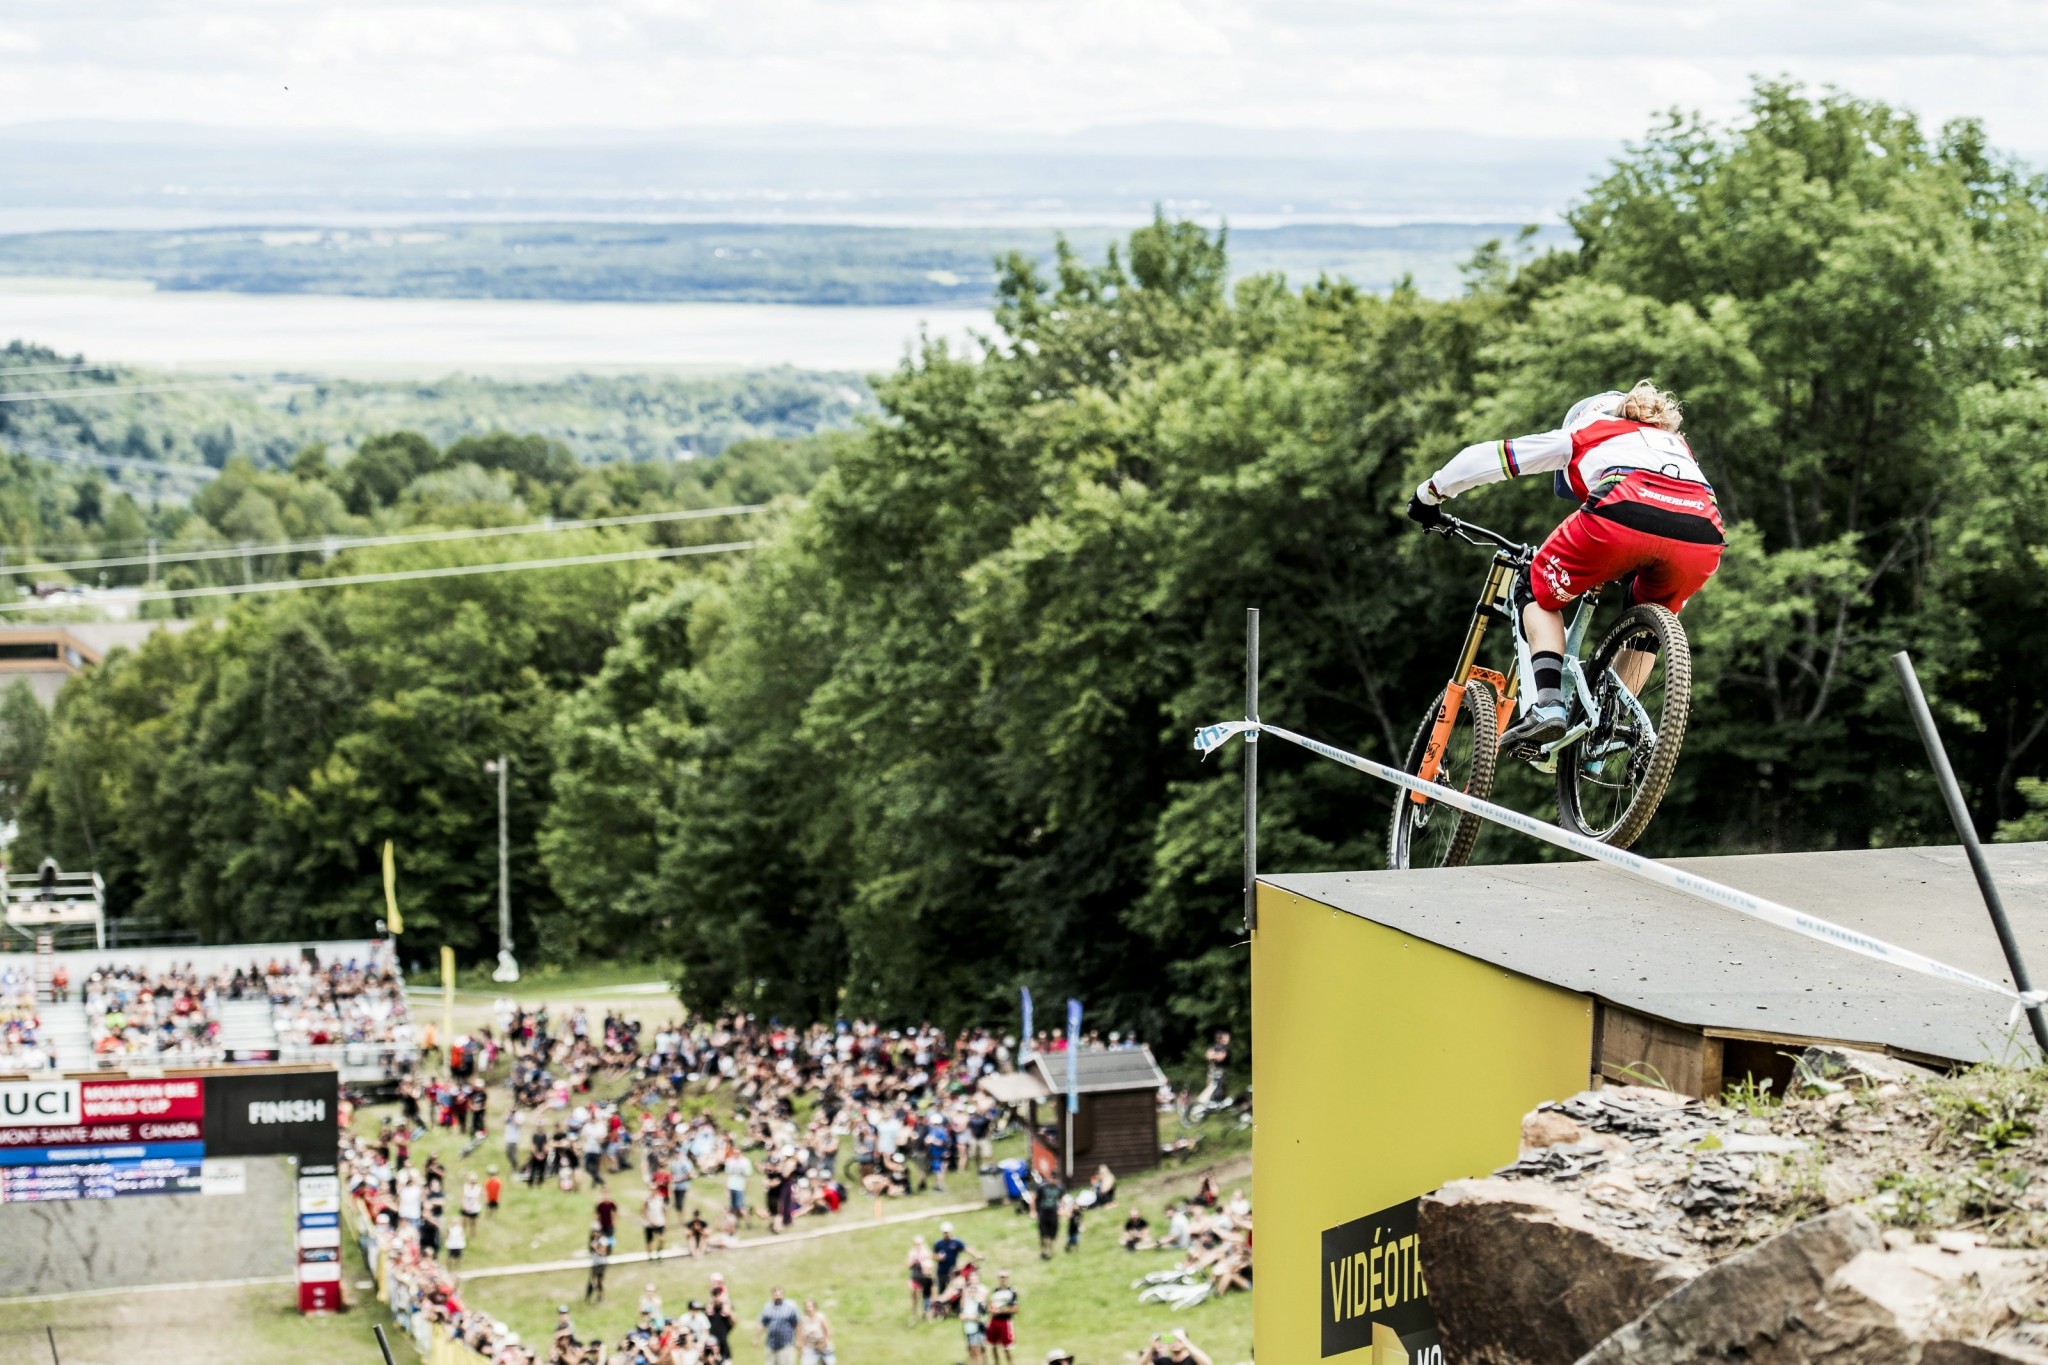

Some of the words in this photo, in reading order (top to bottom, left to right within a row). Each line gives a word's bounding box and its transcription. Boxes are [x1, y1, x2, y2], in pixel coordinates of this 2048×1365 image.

[84, 1085, 163, 1100] MOUNTAIN
[164, 1083, 198, 1098] BIKE
[5, 1091, 69, 1115] UCI
[84, 1100, 138, 1116] WORLD
[139, 1099, 171, 1114] CUP
[249, 1099, 326, 1124] FINISH
[139, 1122, 200, 1139] CANADA
[1330, 1227, 1428, 1323] VIDÉOTR
